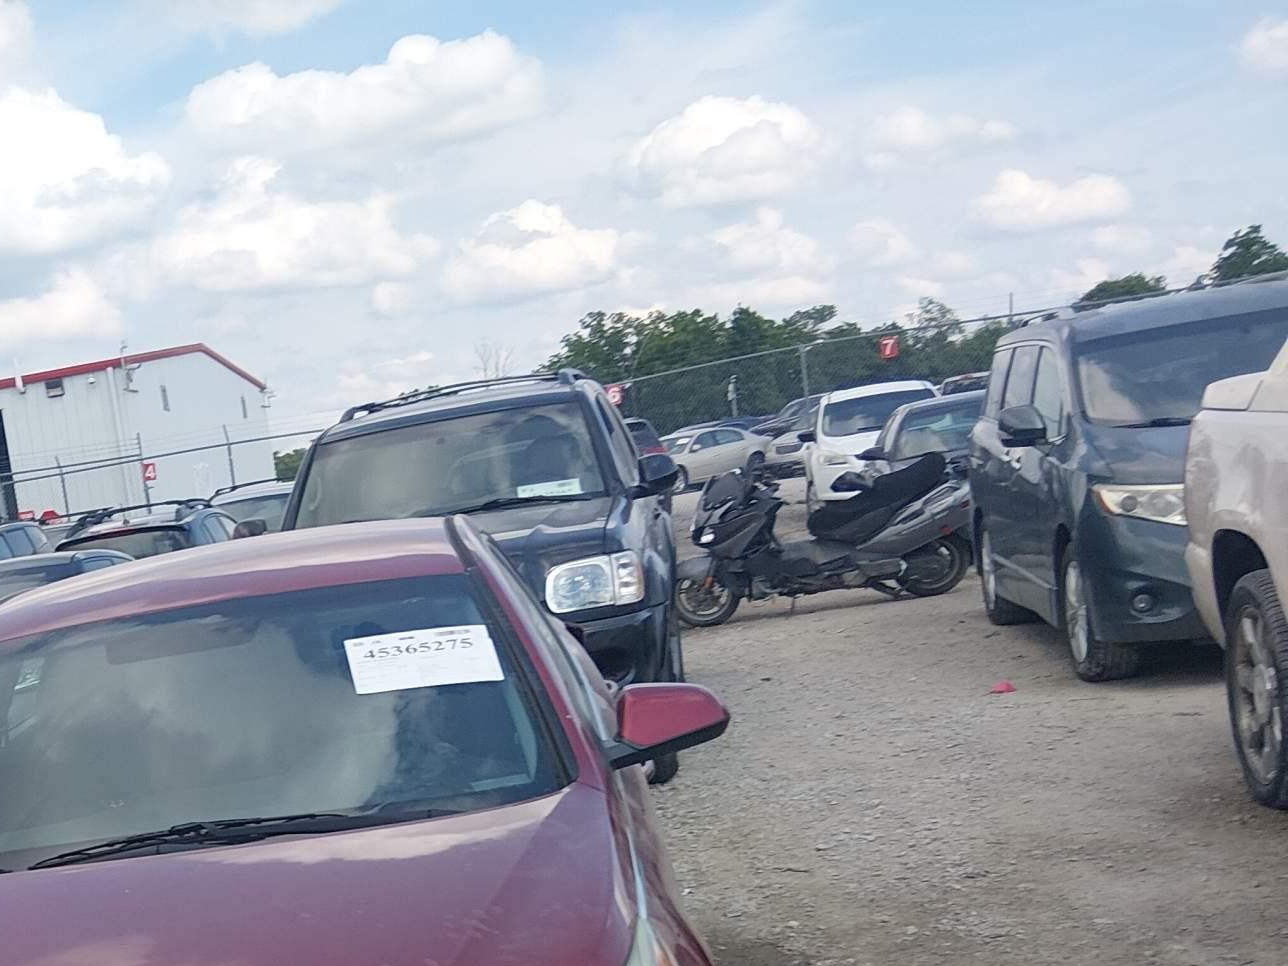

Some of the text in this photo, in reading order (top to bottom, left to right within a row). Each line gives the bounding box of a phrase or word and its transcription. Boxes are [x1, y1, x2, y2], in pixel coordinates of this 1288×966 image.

[882, 339, 895, 356] 7
[607, 386, 622, 405] 6
[145, 464, 157, 480] 4
[363, 637, 474, 659] 45365275
